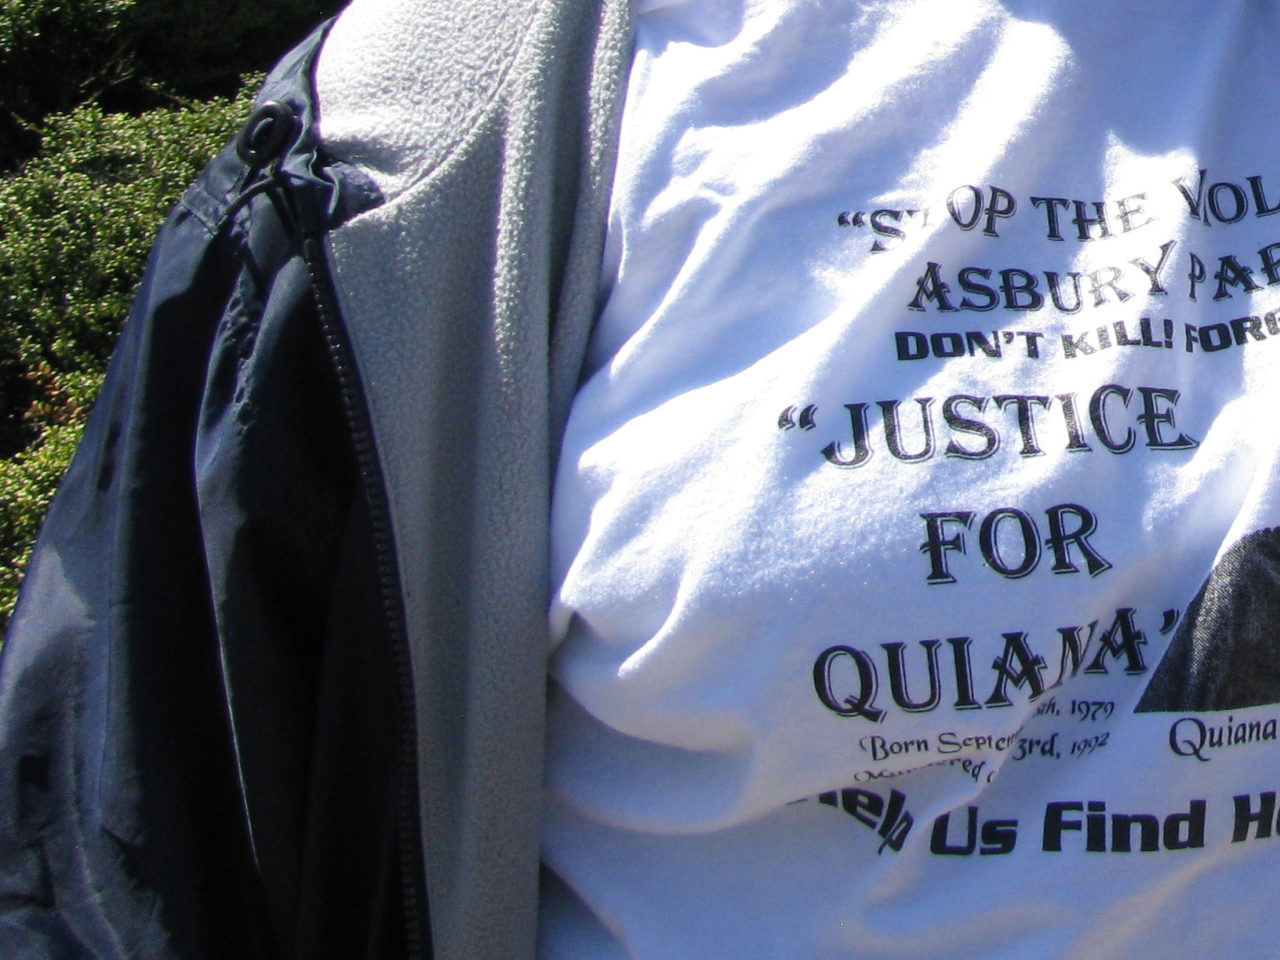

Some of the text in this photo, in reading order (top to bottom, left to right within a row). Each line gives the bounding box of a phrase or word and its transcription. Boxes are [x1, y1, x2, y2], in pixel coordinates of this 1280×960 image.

[1030, 193, 1160, 242] THE
[907, 239, 1177, 314] ASBURY
[895, 330, 1043, 361] DON'T
[1062, 319, 1174, 360] KILL!
[777, 384, 1199, 469] “JUSTICE
[919, 503, 1113, 585] FOR
[859, 735, 929, 761] Born
[1071, 699, 1116, 722] 1979
[1012, 732, 1110, 761] 3rd, 1992
[1169, 716, 1277, 762] Quiana
[929, 805, 1018, 856] Us
[1042, 799, 1207, 855] Find
